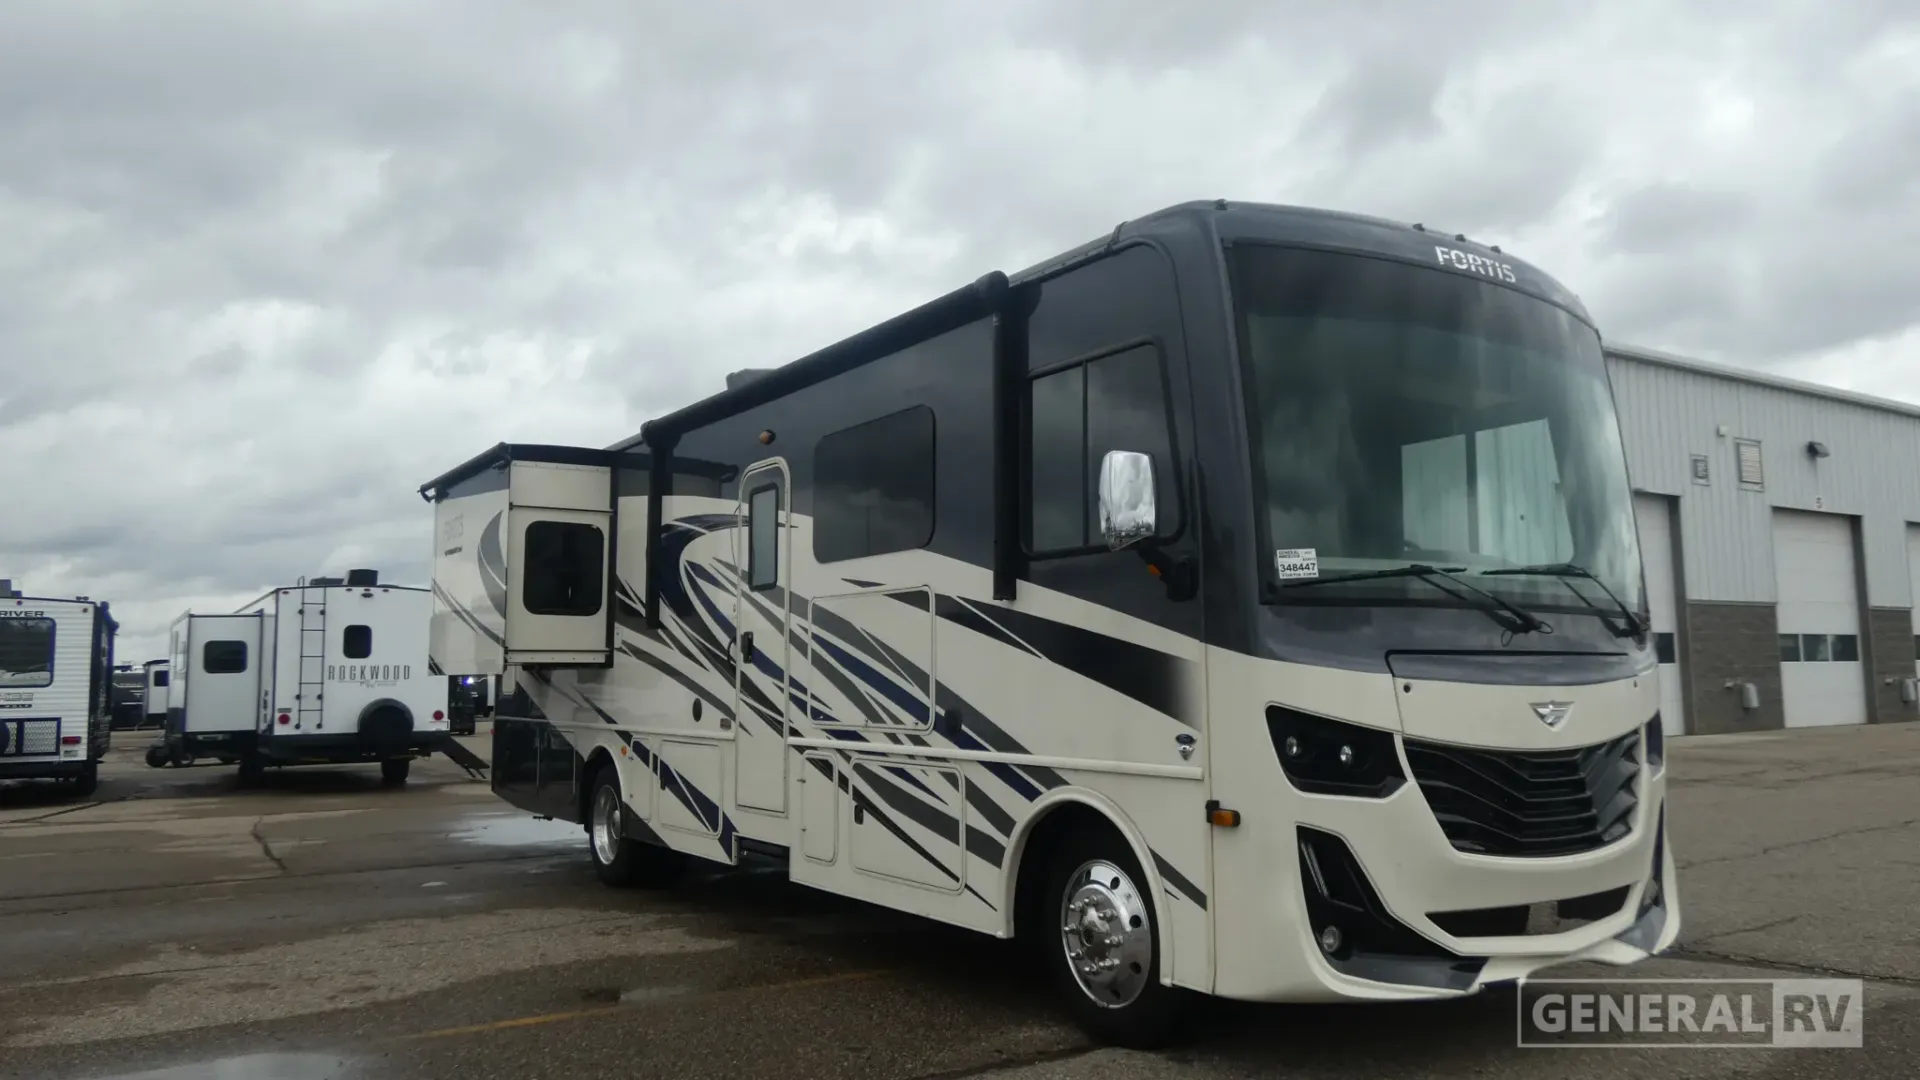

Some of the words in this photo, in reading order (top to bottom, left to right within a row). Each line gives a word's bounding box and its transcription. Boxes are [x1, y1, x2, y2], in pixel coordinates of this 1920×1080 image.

[1435, 246, 1516, 283] FORTIS
[1280, 562, 1315, 573] 348447
[328, 664, 410, 681] ROCKWOOD
